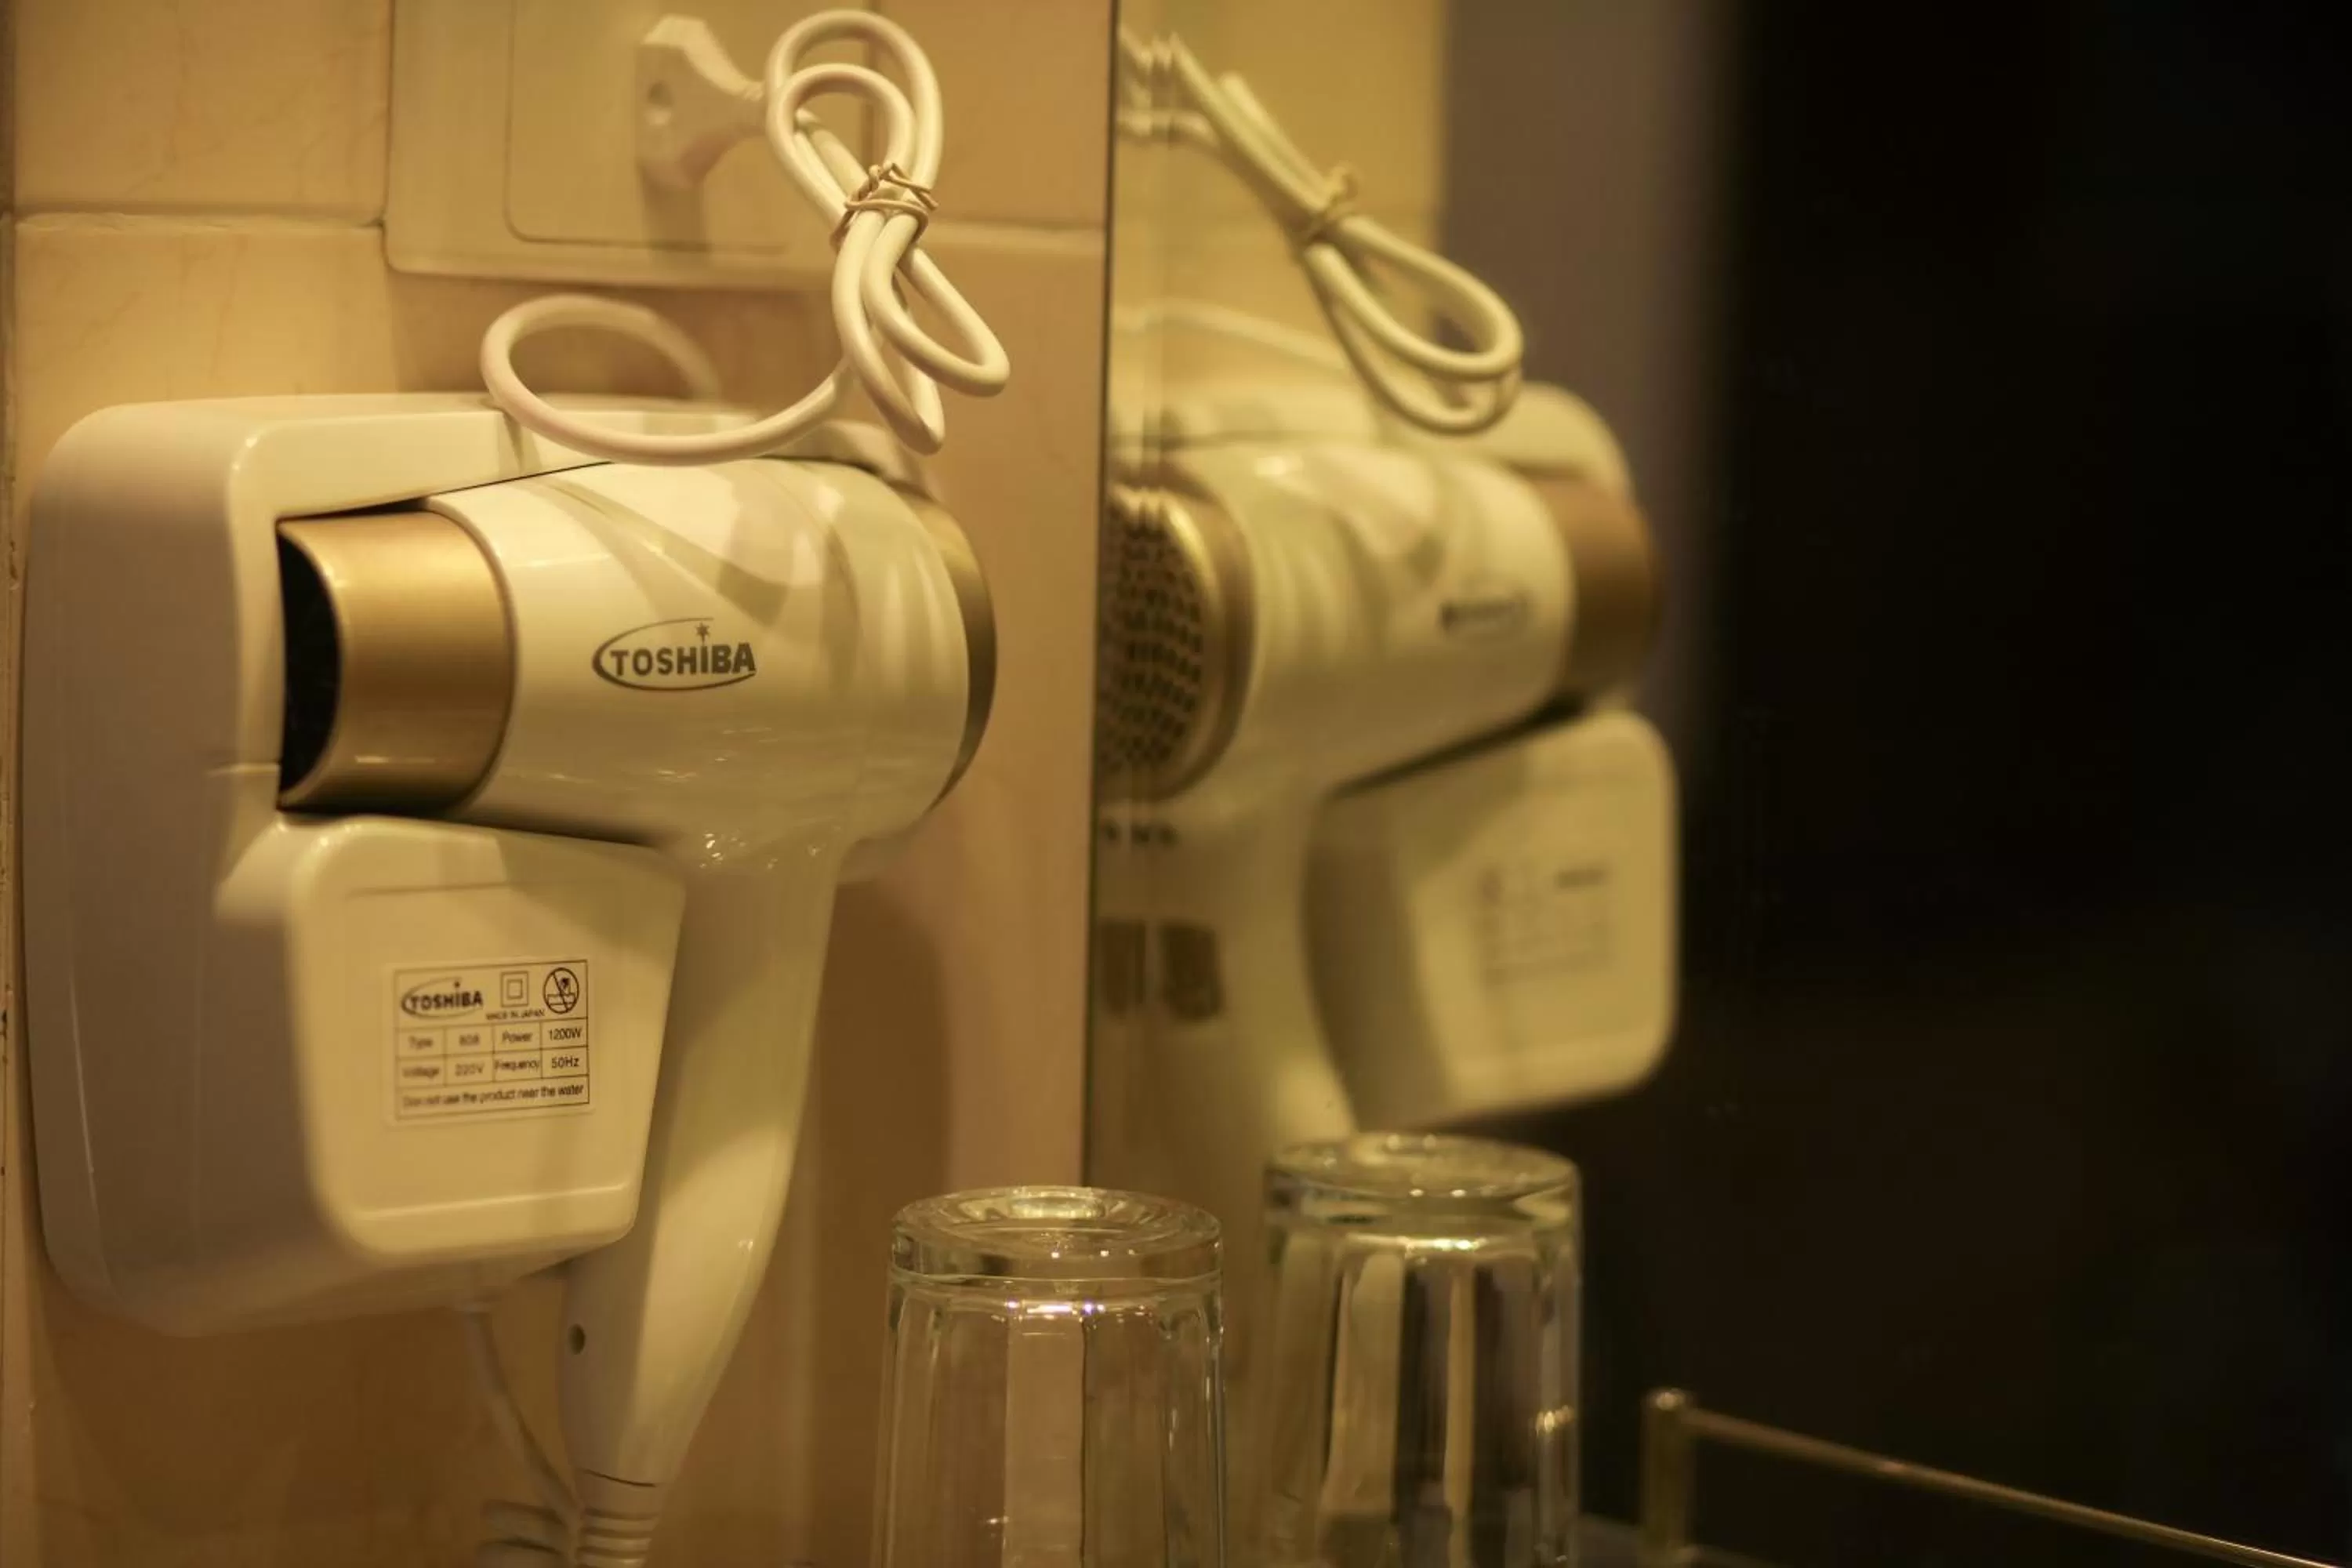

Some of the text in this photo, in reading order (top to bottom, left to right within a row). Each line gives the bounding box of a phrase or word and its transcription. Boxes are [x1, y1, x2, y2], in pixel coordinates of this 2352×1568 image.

[610, 642, 757, 676] TOSHIBA
[410, 990, 484, 1011] TOSHIBA
[521, 1008, 546, 1018] JAPAN
[408, 1036, 434, 1050] Type
[502, 1030, 532, 1044] Power
[548, 1027, 582, 1041] 1200W
[402, 1056, 579, 1080] Voltage 220V Frequency 50Hz
[443, 1095, 459, 1105] use
[463, 1091, 477, 1104] the
[479, 1087, 515, 1105] product
[518, 1088, 539, 1098] near
[540, 1086, 556, 1098] the
[557, 1084, 584, 1096] water
